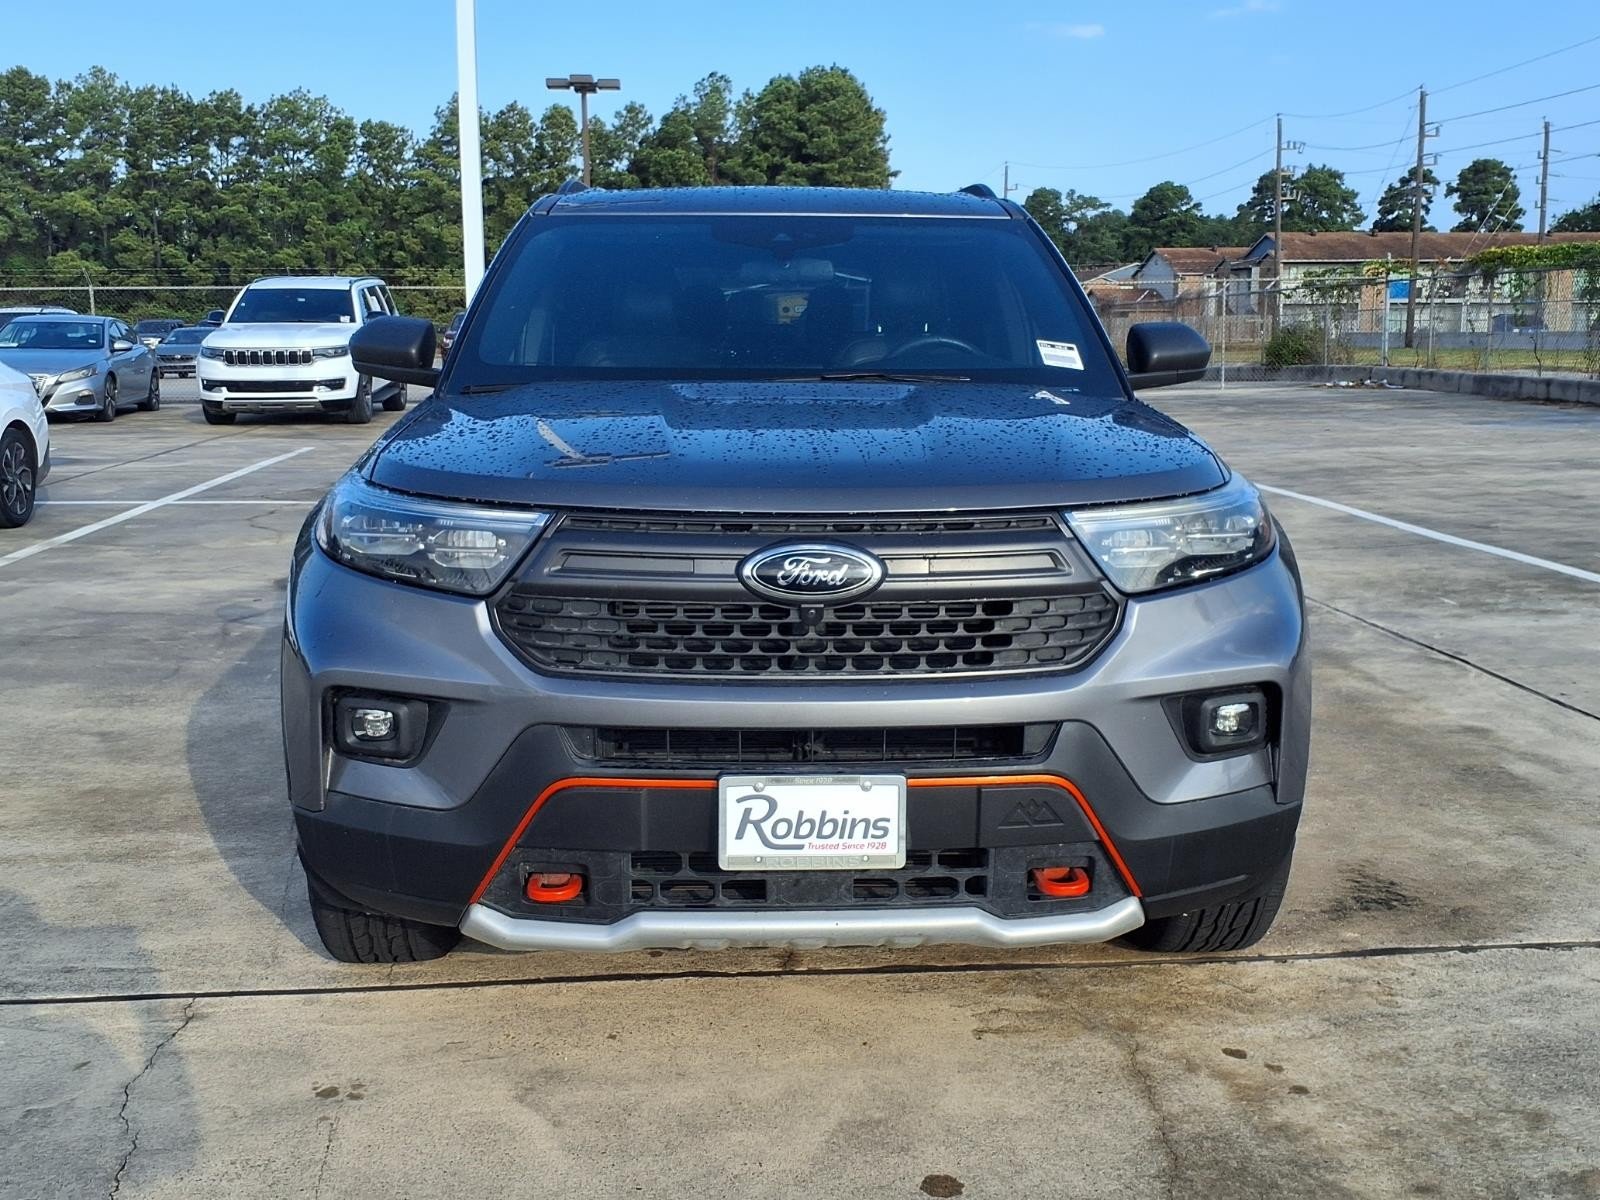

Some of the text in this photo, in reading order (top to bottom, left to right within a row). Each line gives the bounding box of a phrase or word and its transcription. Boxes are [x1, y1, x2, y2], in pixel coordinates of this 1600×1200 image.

[776, 556, 849, 586] Ford
[735, 794, 891, 850] Robbins
[808, 841, 887, 850] Trusted Since 1928
